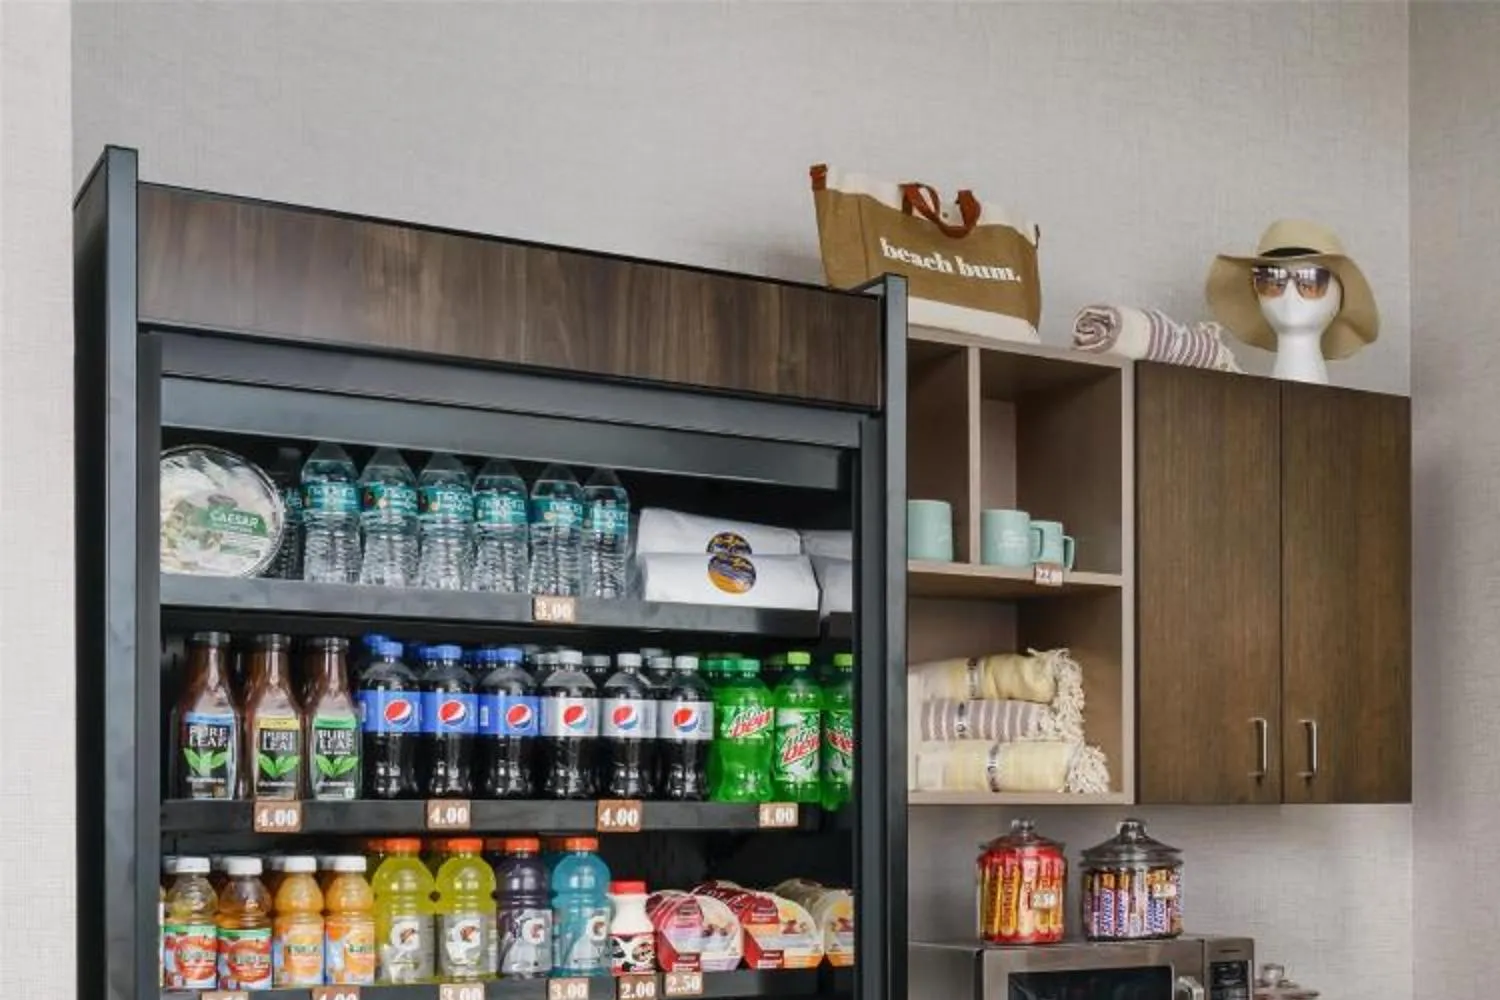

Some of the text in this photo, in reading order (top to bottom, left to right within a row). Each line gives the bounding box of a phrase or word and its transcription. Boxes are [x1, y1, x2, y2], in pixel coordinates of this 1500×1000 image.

[880, 237, 953, 275] beach
[257, 808, 298, 828] 4.00
[429, 806, 468, 825] 4.00
[599, 807, 640, 827] 4.00
[620, 981, 655, 998] 2.00
